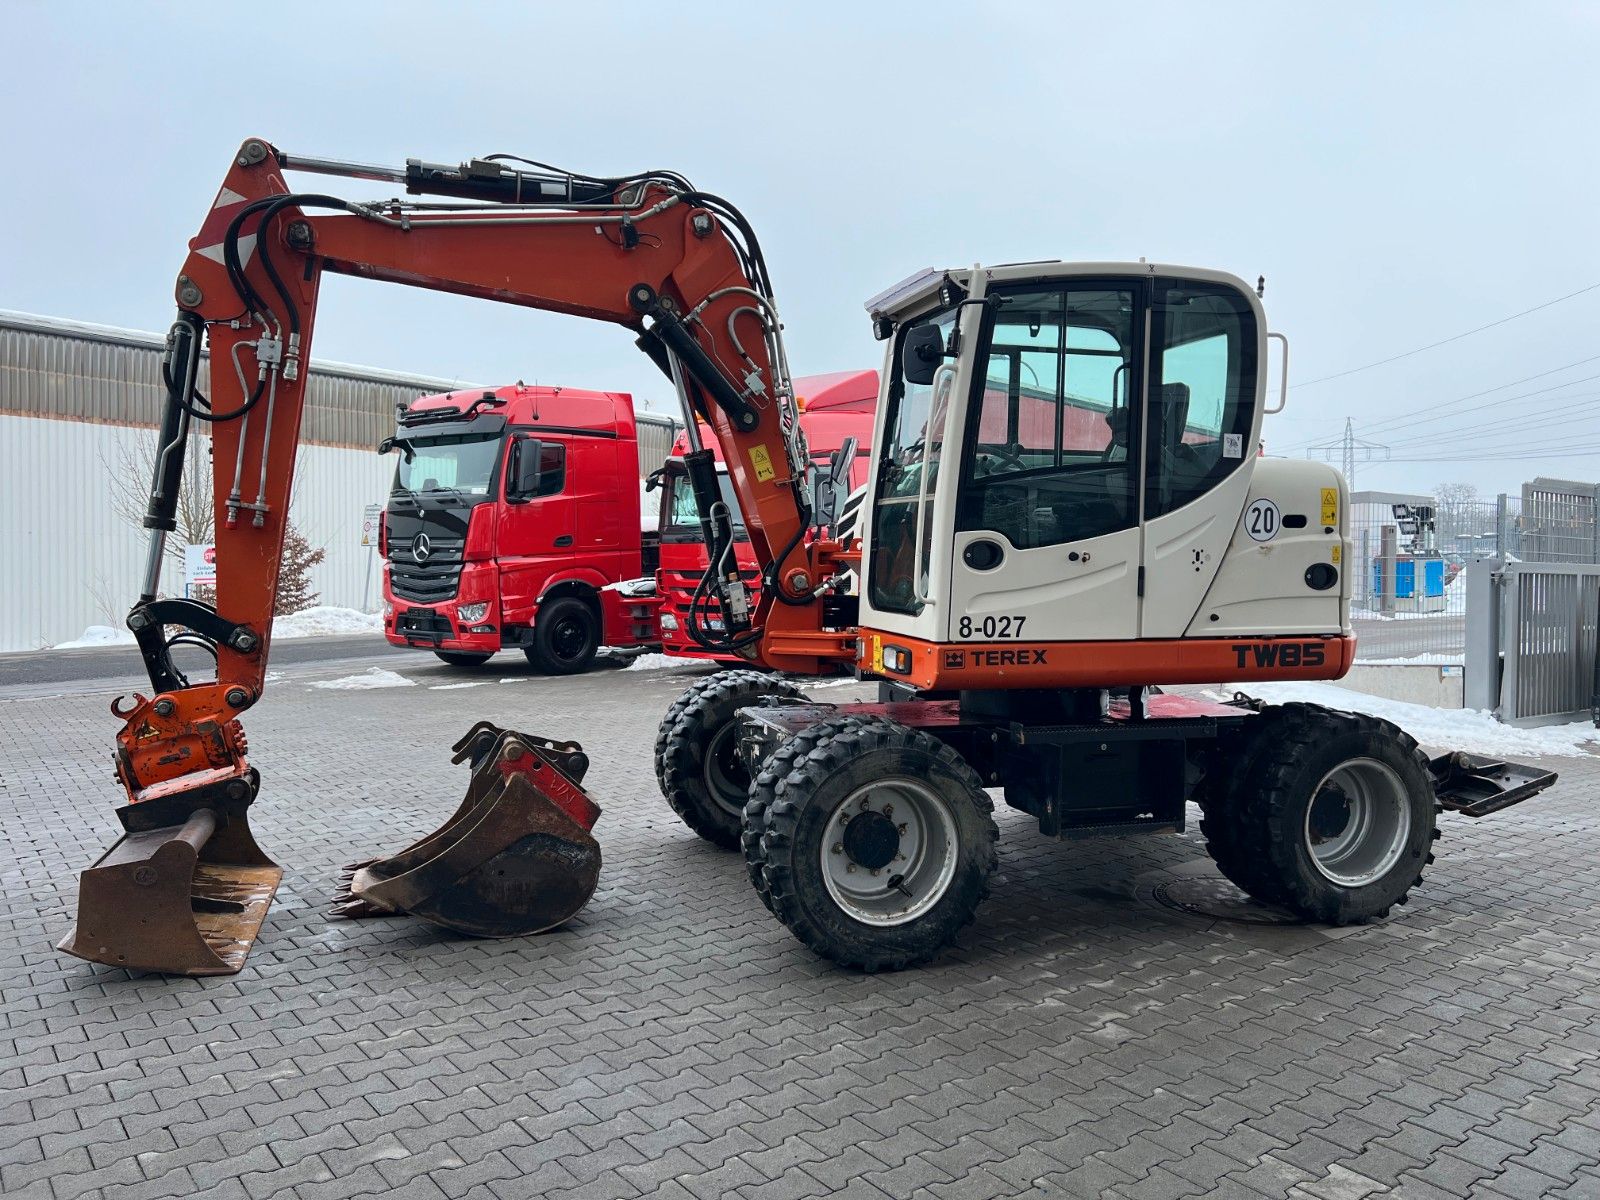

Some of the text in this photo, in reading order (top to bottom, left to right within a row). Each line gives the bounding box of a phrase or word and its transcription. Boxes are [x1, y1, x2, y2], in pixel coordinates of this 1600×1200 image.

[1251, 506, 1274, 534] 20
[959, 615, 1027, 639] 8-027
[970, 649, 1048, 667] TEREX
[1231, 643, 1326, 669] TW85
